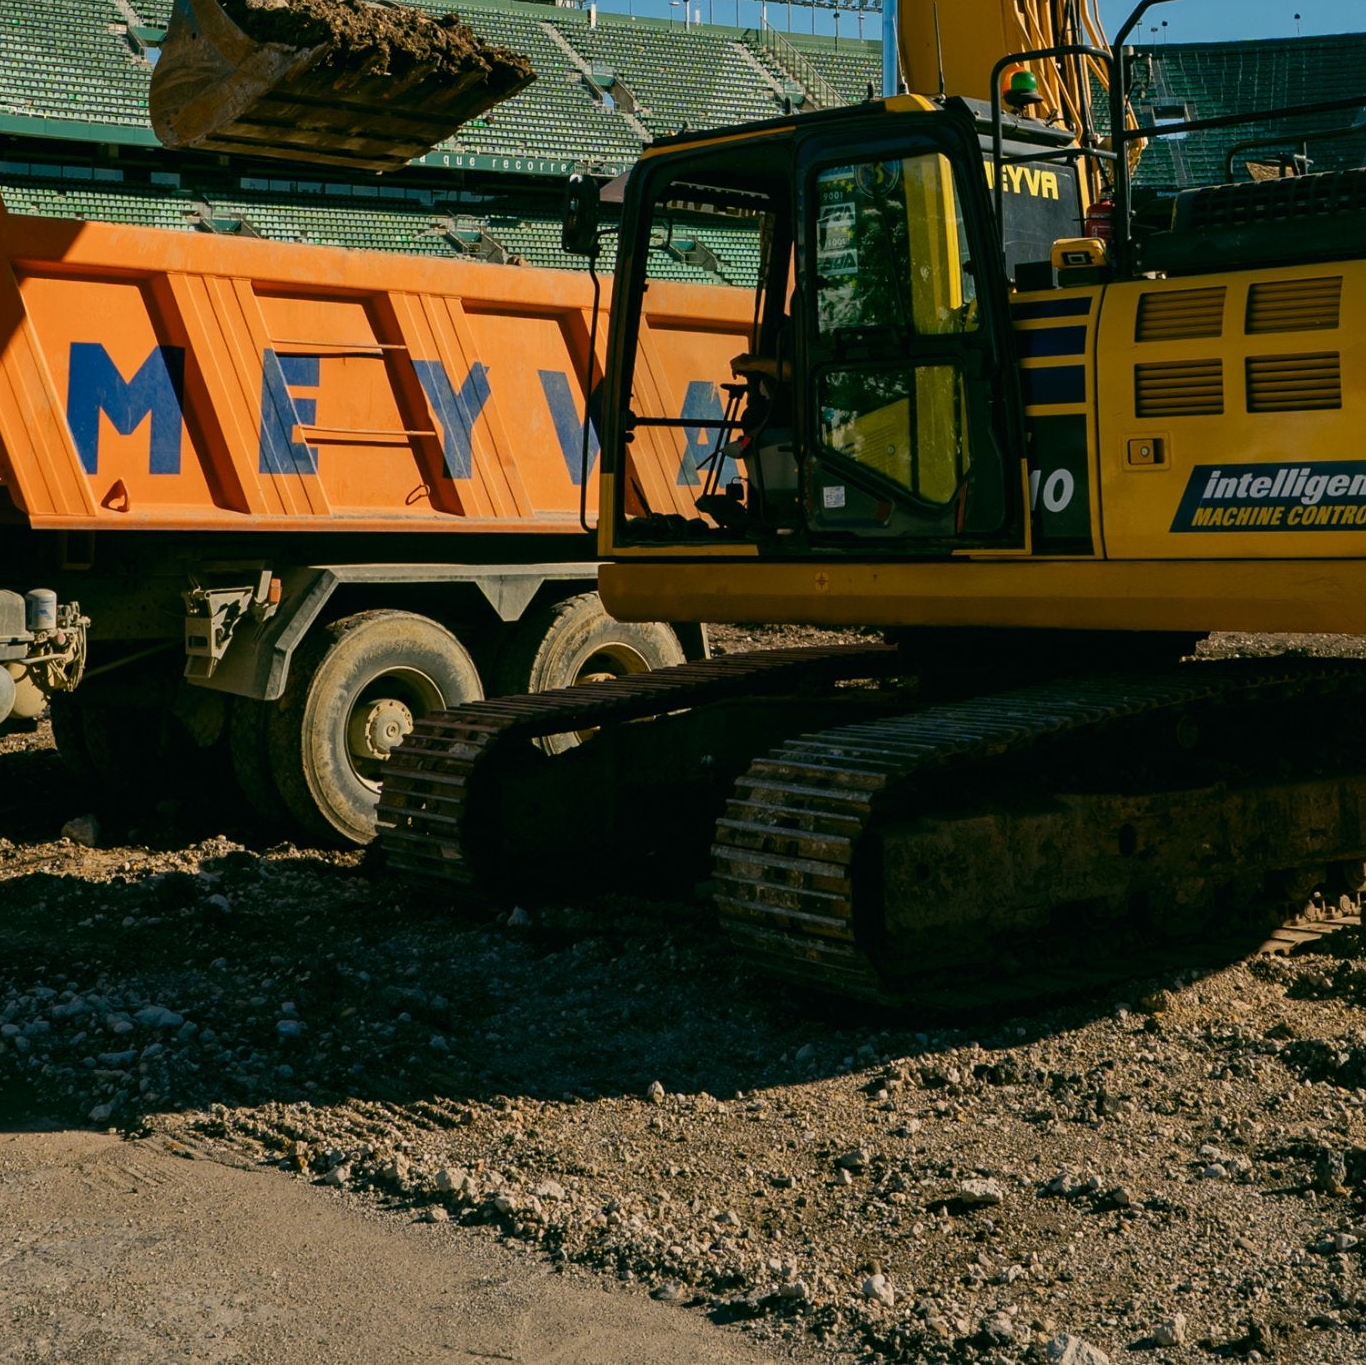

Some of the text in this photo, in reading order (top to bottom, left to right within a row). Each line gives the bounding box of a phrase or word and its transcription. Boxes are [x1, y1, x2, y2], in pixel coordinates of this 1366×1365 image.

[443, 155, 567, 172] que recorre
[1191, 506, 1285, 526] MACHINE
